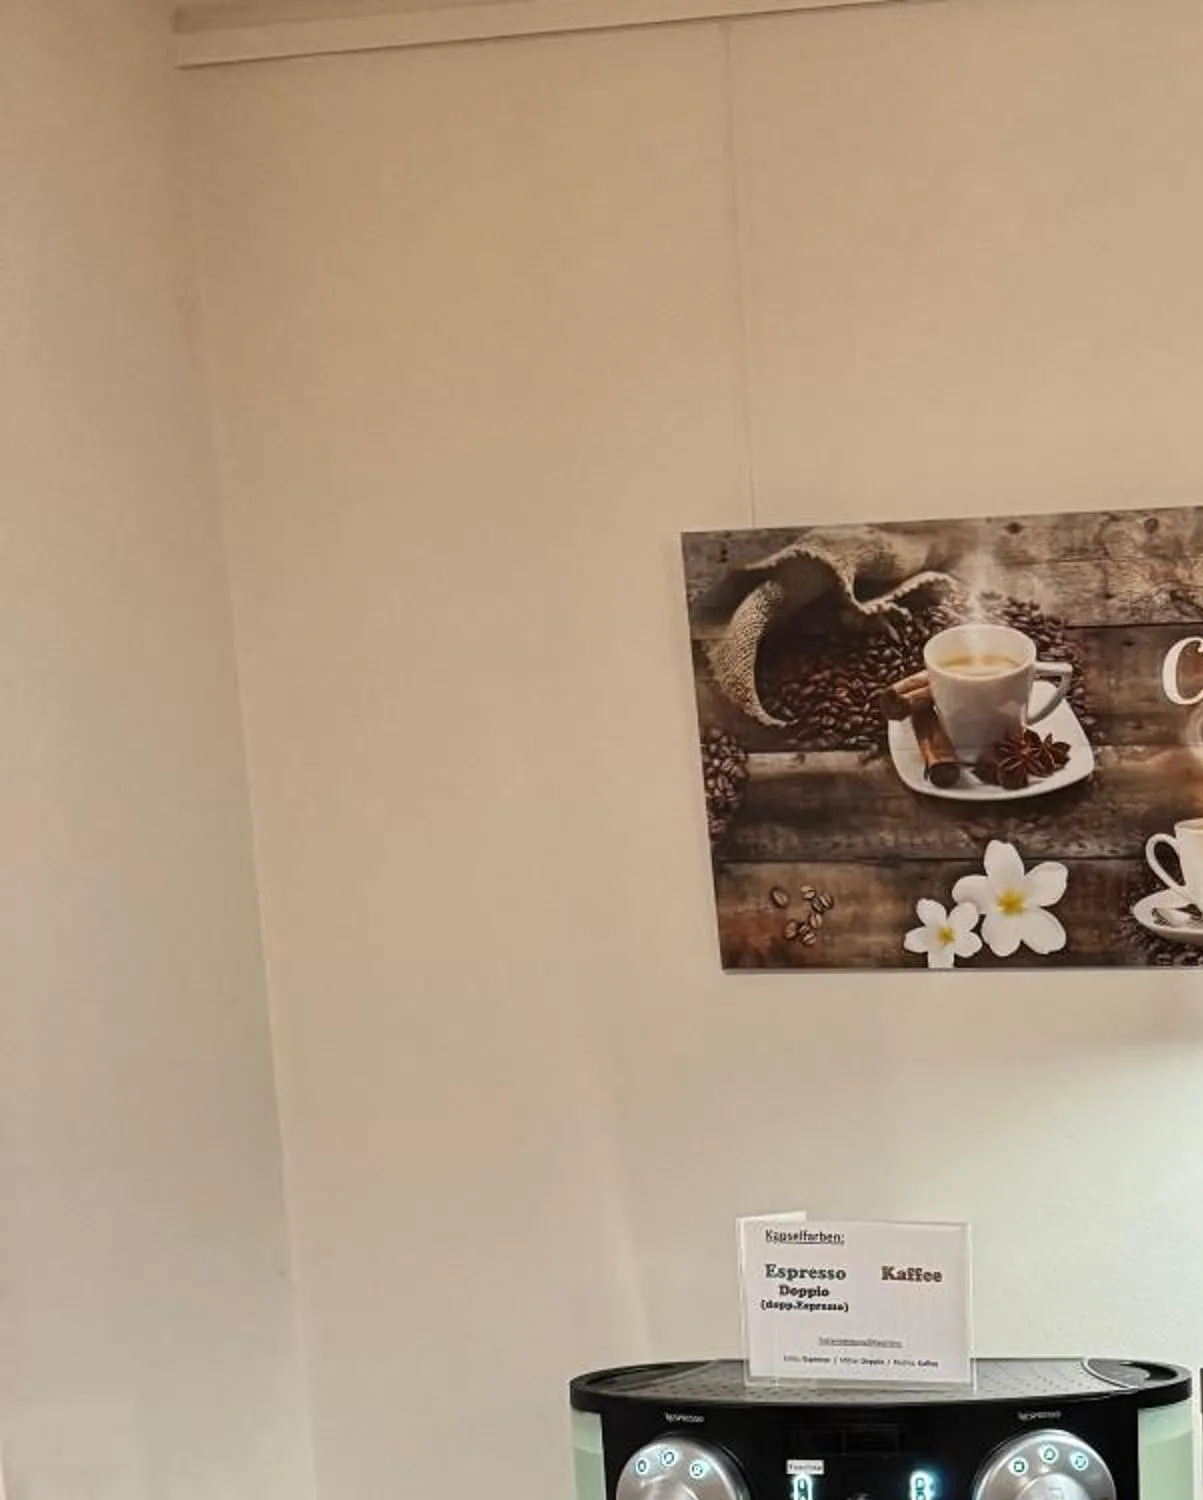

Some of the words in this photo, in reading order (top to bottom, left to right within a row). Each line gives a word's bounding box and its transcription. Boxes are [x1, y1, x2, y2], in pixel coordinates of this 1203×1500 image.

[765, 1229, 845, 1246] Kapselfarben:
[765, 1263, 847, 1281] Espresso
[880, 1265, 943, 1283] Kaffee
[778, 1284, 831, 1299] Doppio
